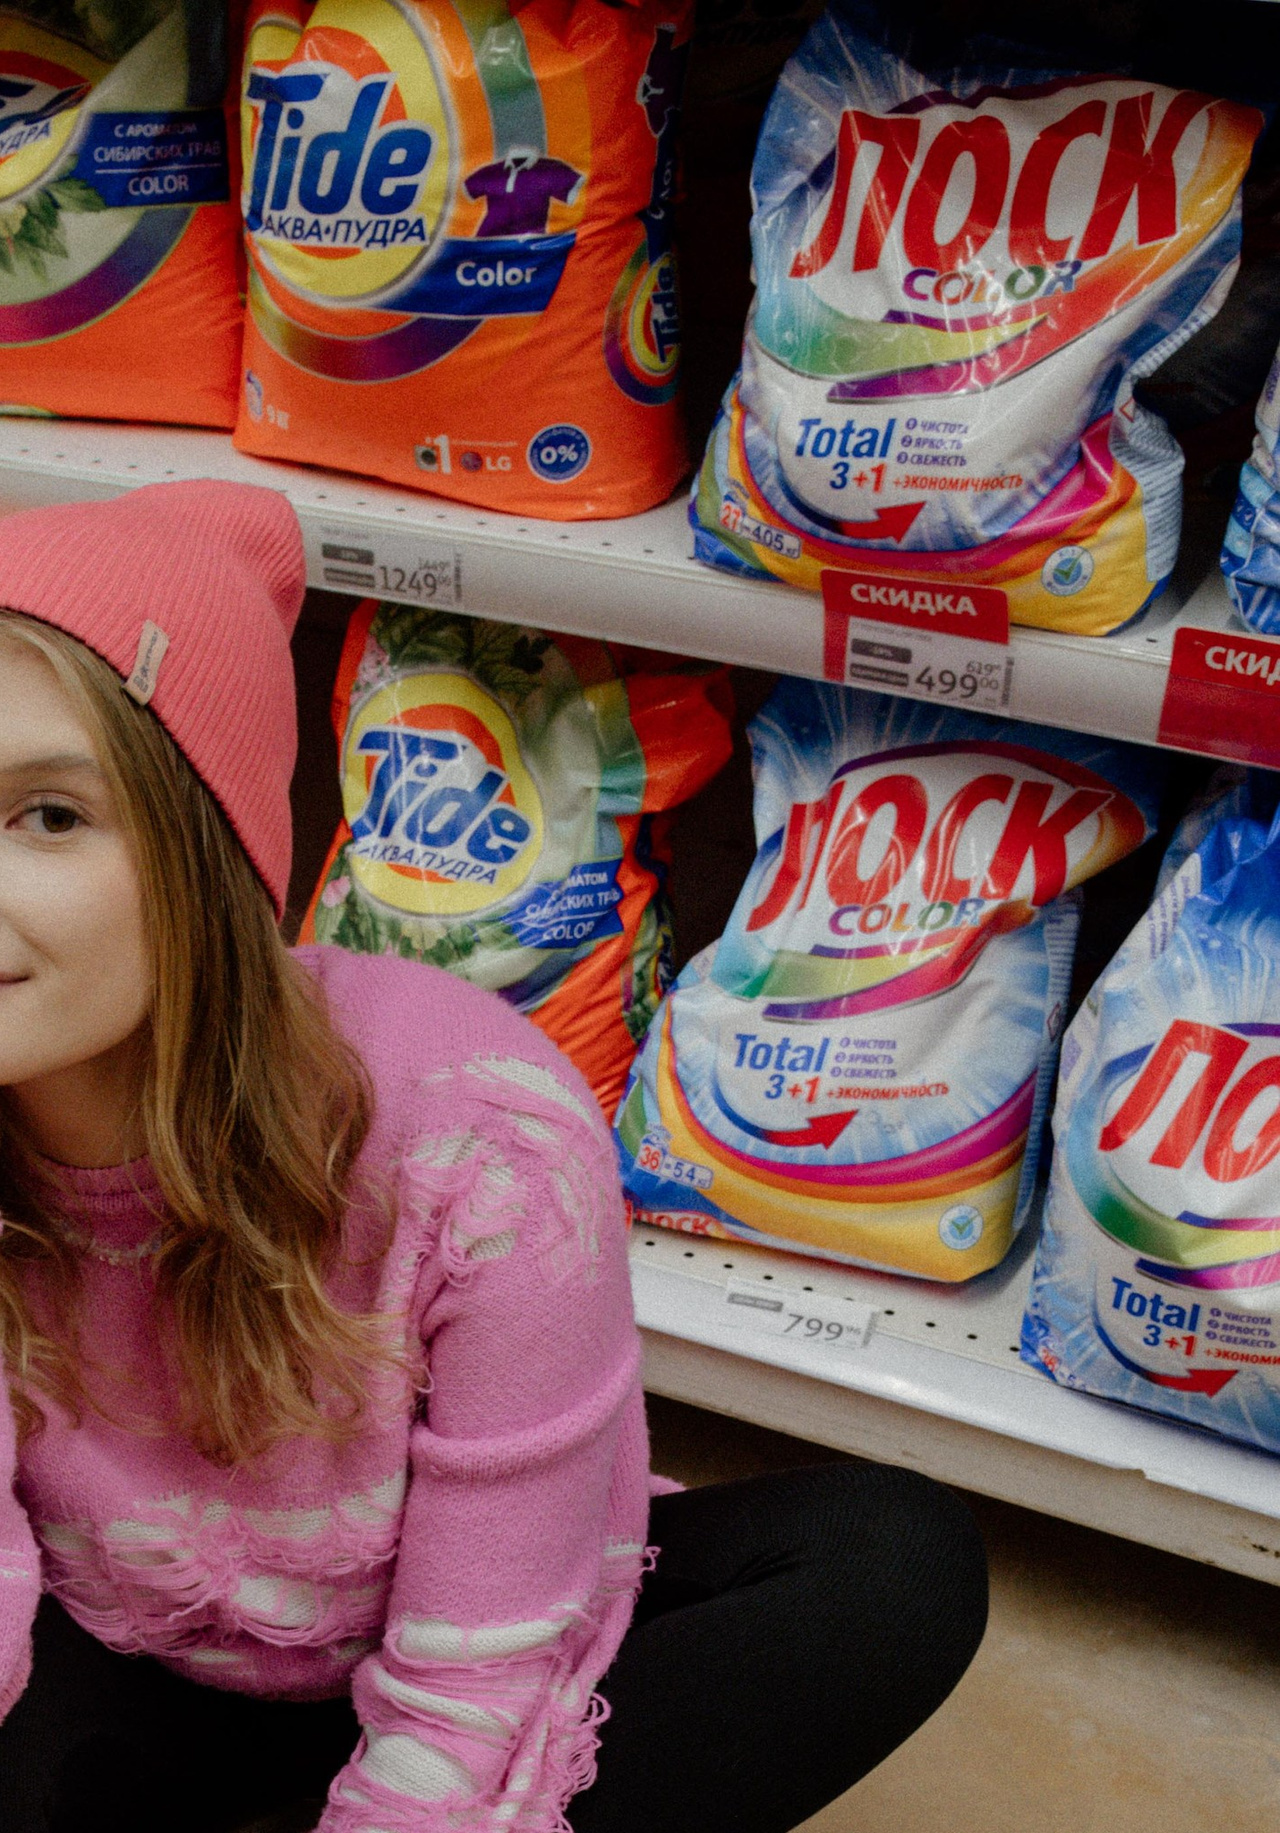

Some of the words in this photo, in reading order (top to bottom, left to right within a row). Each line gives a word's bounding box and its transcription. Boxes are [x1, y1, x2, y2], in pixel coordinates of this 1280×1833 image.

[93, 144, 184, 163] СИБИРСКИХ
[245, 69, 433, 232] Tide
[127, 174, 189, 196] COLOR
[788, 89, 1220, 279] ЛОСК
[456, 260, 538, 288] Color
[903, 258, 1083, 306] COLOR
[794, 417, 897, 460] Total
[919, 418, 969, 435] ЧИСТОТА
[485, 456, 512, 472] LG
[540, 443, 579, 466] 0%
[909, 451, 968, 467] СВЕЖЕСТЬ
[721, 503, 742, 532] 27
[379, 565, 427, 597] 1249
[850, 582, 978, 617] СКИДКА
[915, 665, 979, 699] 499
[351, 730, 532, 864] Tide
[746, 773, 1114, 933] ЛОСК
[828, 897, 987, 937] COLOR
[734, 1033, 831, 1074] Total
[852, 1037, 898, 1051] ЧИСТОТА
[843, 1066, 898, 1080] СВЕЖЕСТЬ
[847, 1052, 894, 1066] ЯРКОСТЬ
[639, 1145, 661, 1172] 36
[1111, 1275, 1202, 1333] Total
[783, 1313, 844, 1342] 799
[1221, 1322, 1271, 1338] ЯРКОСТЬ
[1223, 1311, 1273, 1326] ЧИСТОТА
[1219, 1333, 1278, 1350] СВЕЖЕСТЬ
